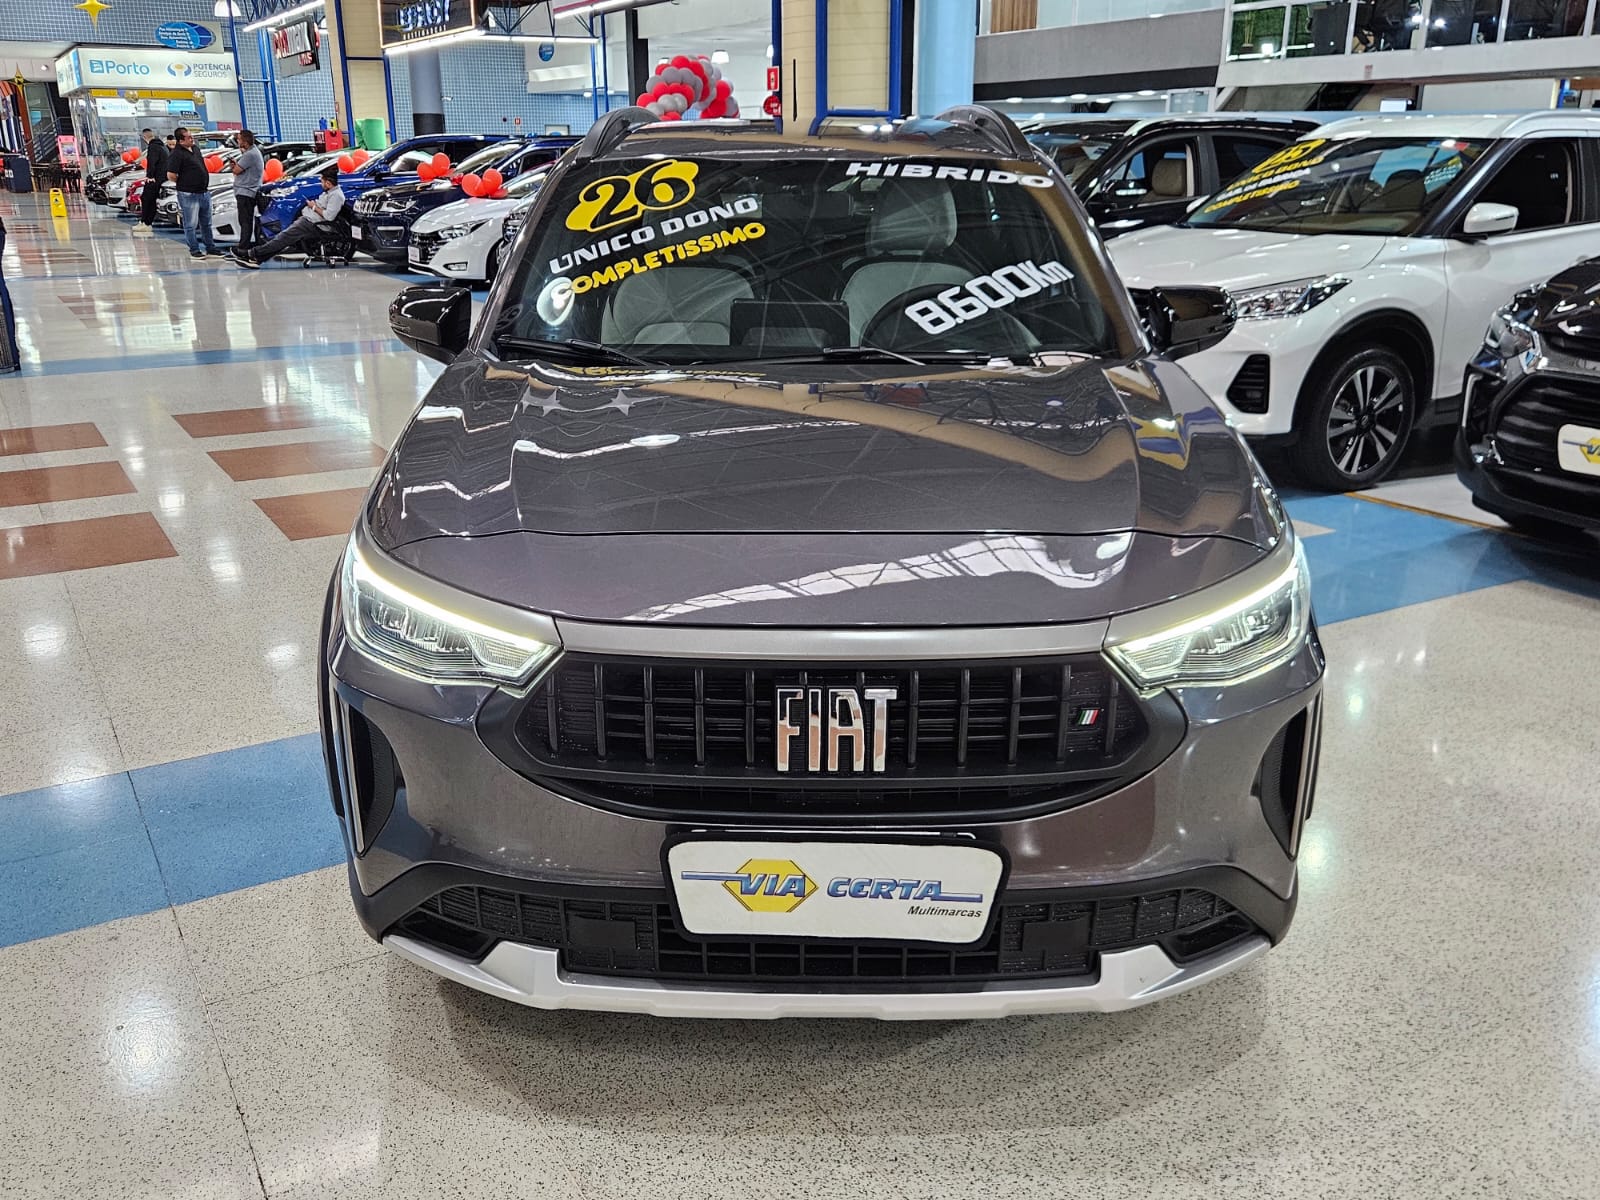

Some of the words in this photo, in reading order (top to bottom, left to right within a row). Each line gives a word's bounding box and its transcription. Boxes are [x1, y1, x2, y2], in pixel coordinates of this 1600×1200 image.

[106, 60, 150, 76] Porto
[566, 159, 699, 232] 26
[660, 197, 759, 236] DONO
[776, 687, 898, 773] FIAT
[739, 872, 807, 898] VIA
[826, 876, 945, 901] CERTA
[907, 905, 983, 919] Multimarcas
